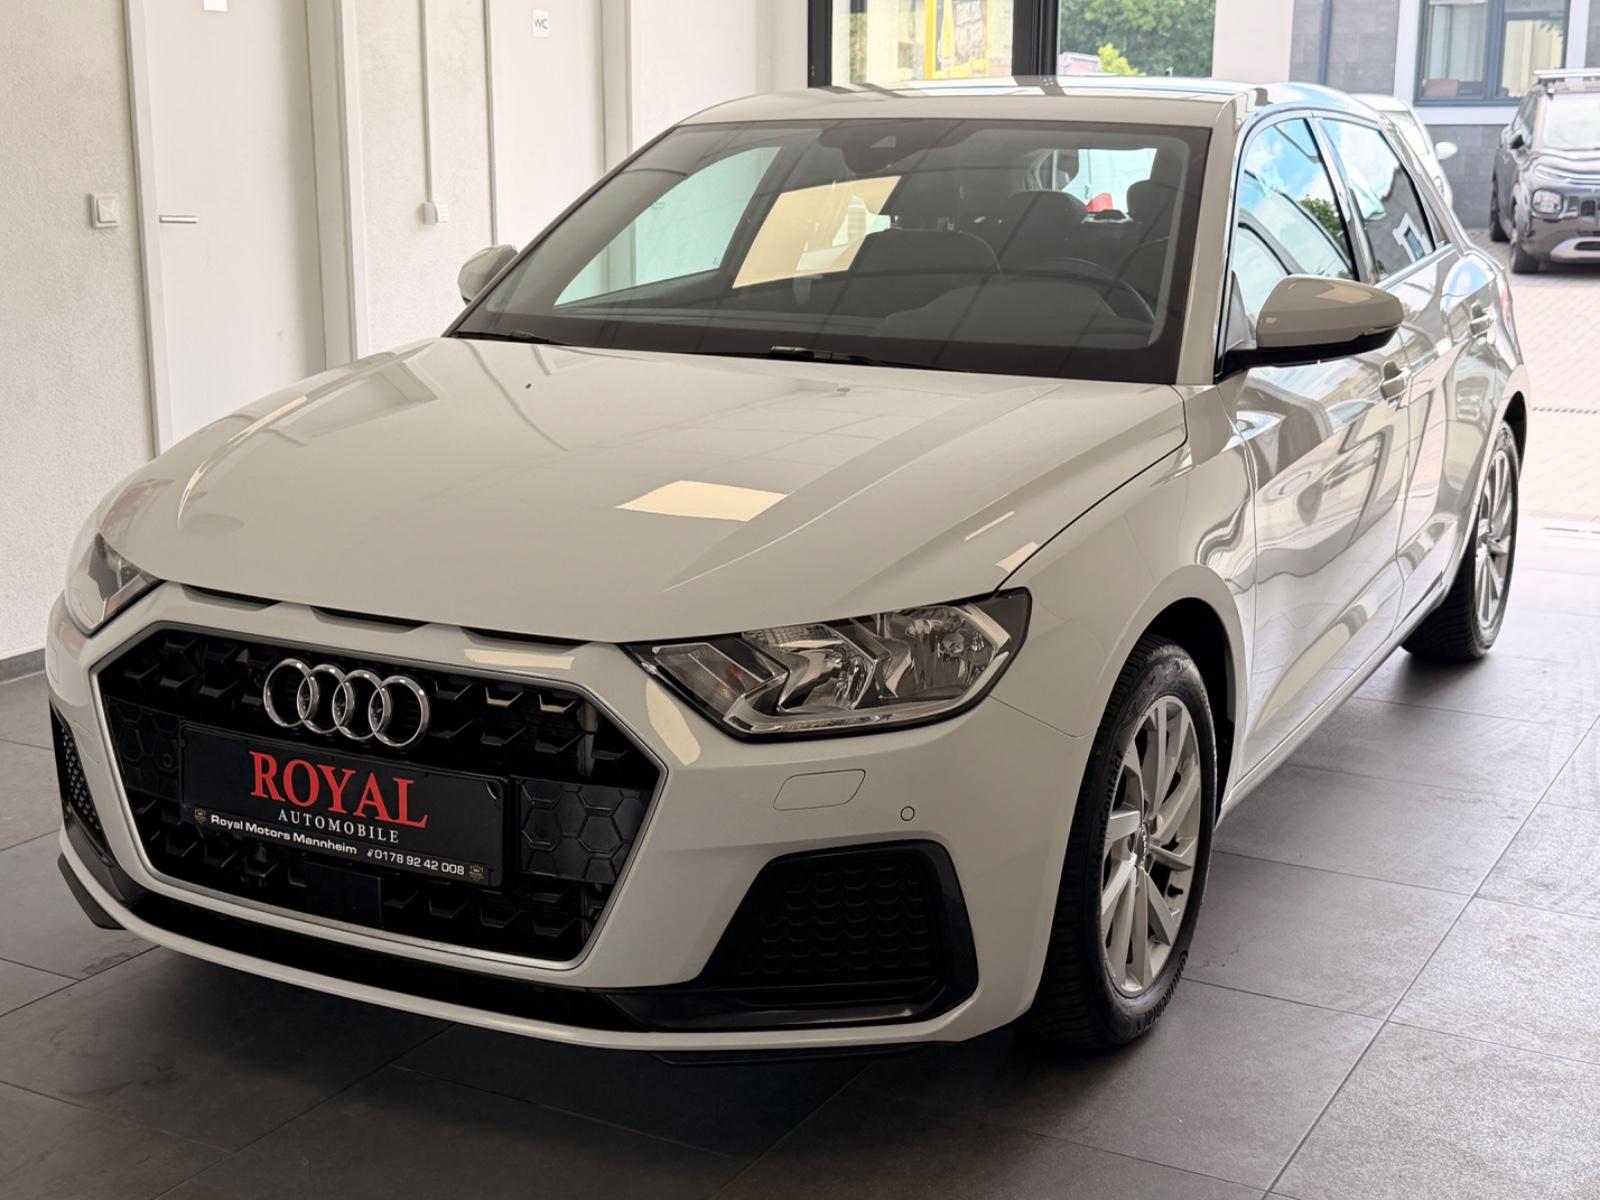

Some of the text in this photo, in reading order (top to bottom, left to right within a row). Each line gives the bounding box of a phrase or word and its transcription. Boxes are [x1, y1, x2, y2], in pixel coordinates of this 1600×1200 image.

[534, 18, 548, 30] WC
[250, 751, 428, 829] ROYAL
[211, 814, 465, 875] Royal Motors Mannheim 0178 92 42 008
[278, 809, 399, 843] AUTOMOBILE
